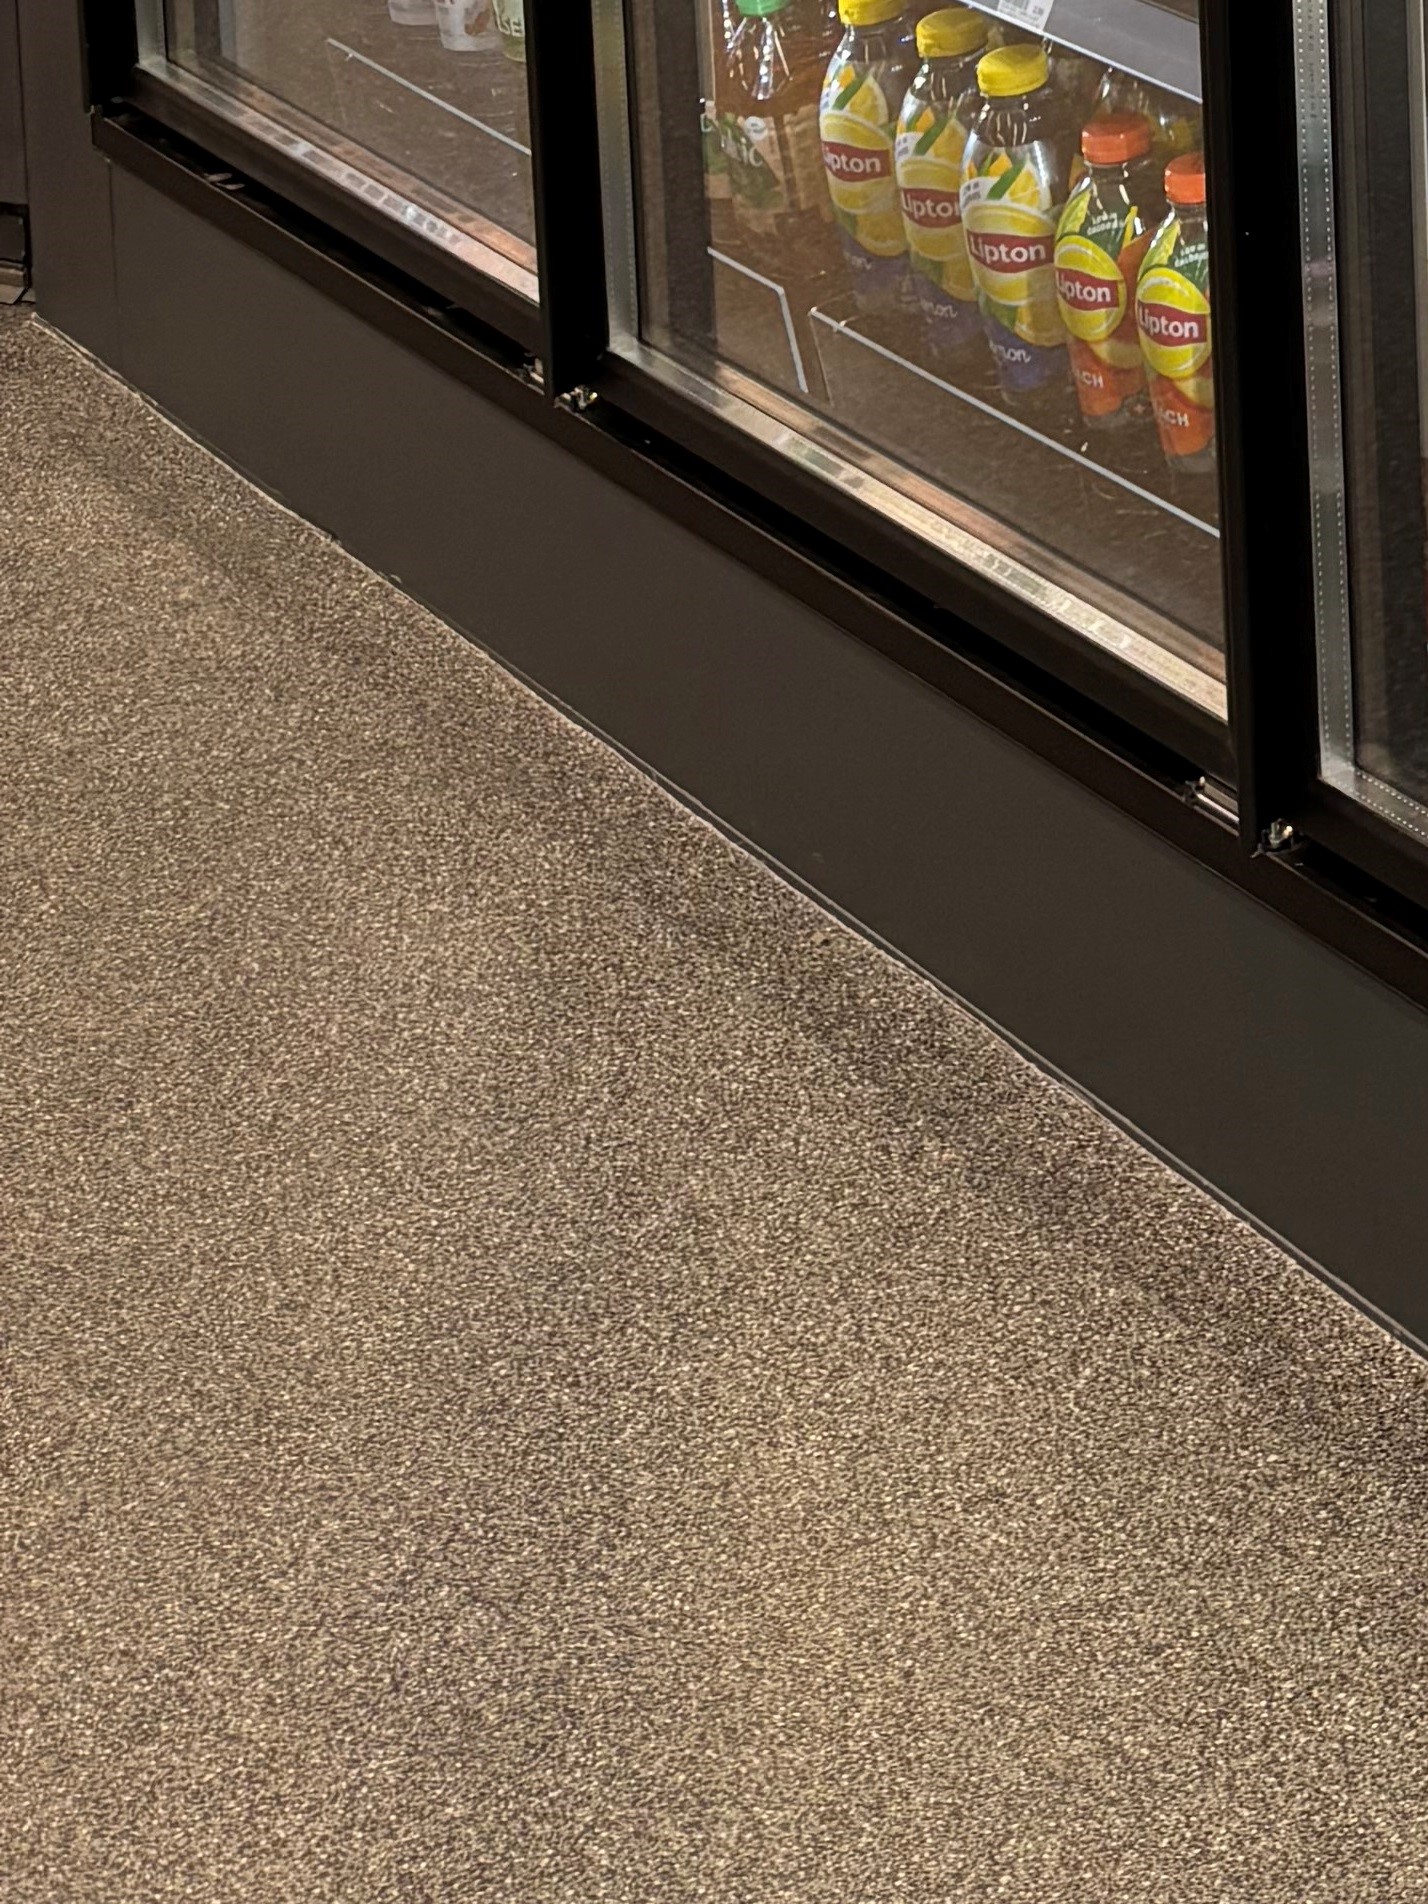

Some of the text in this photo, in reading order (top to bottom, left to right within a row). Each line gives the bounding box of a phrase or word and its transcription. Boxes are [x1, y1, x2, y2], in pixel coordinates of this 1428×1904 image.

[970, 236, 1047, 264] Lipton
[1056, 269, 1112, 303] Lipton
[1139, 307, 1199, 340] Lipton
